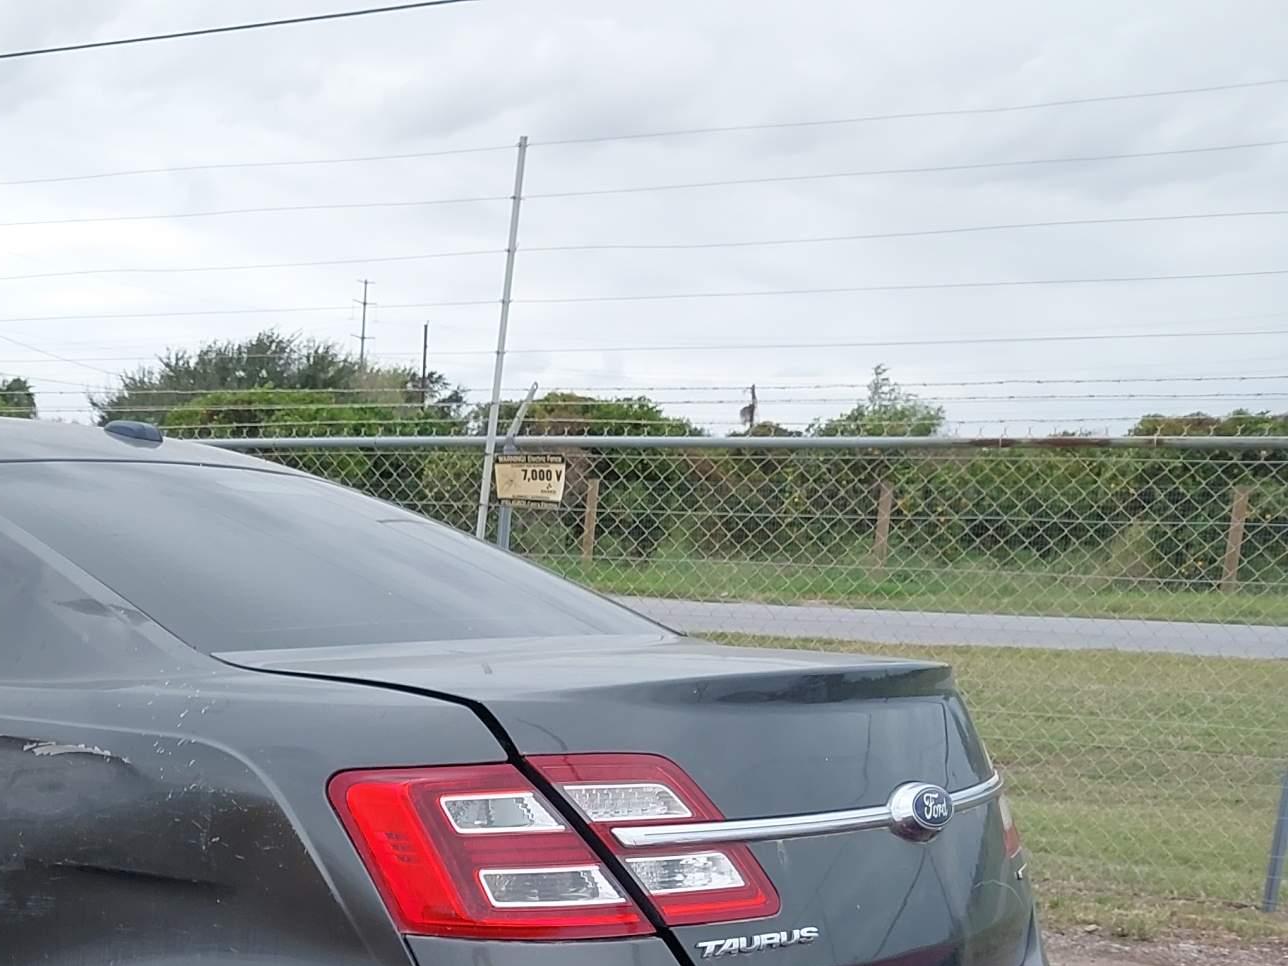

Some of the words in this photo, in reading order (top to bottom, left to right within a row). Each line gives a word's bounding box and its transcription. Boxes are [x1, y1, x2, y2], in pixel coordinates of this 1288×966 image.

[521, 468, 552, 482] 7,000
[555, 469, 562, 482] V
[923, 793, 949, 820] Ford
[696, 926, 819, 958] TAURUS
